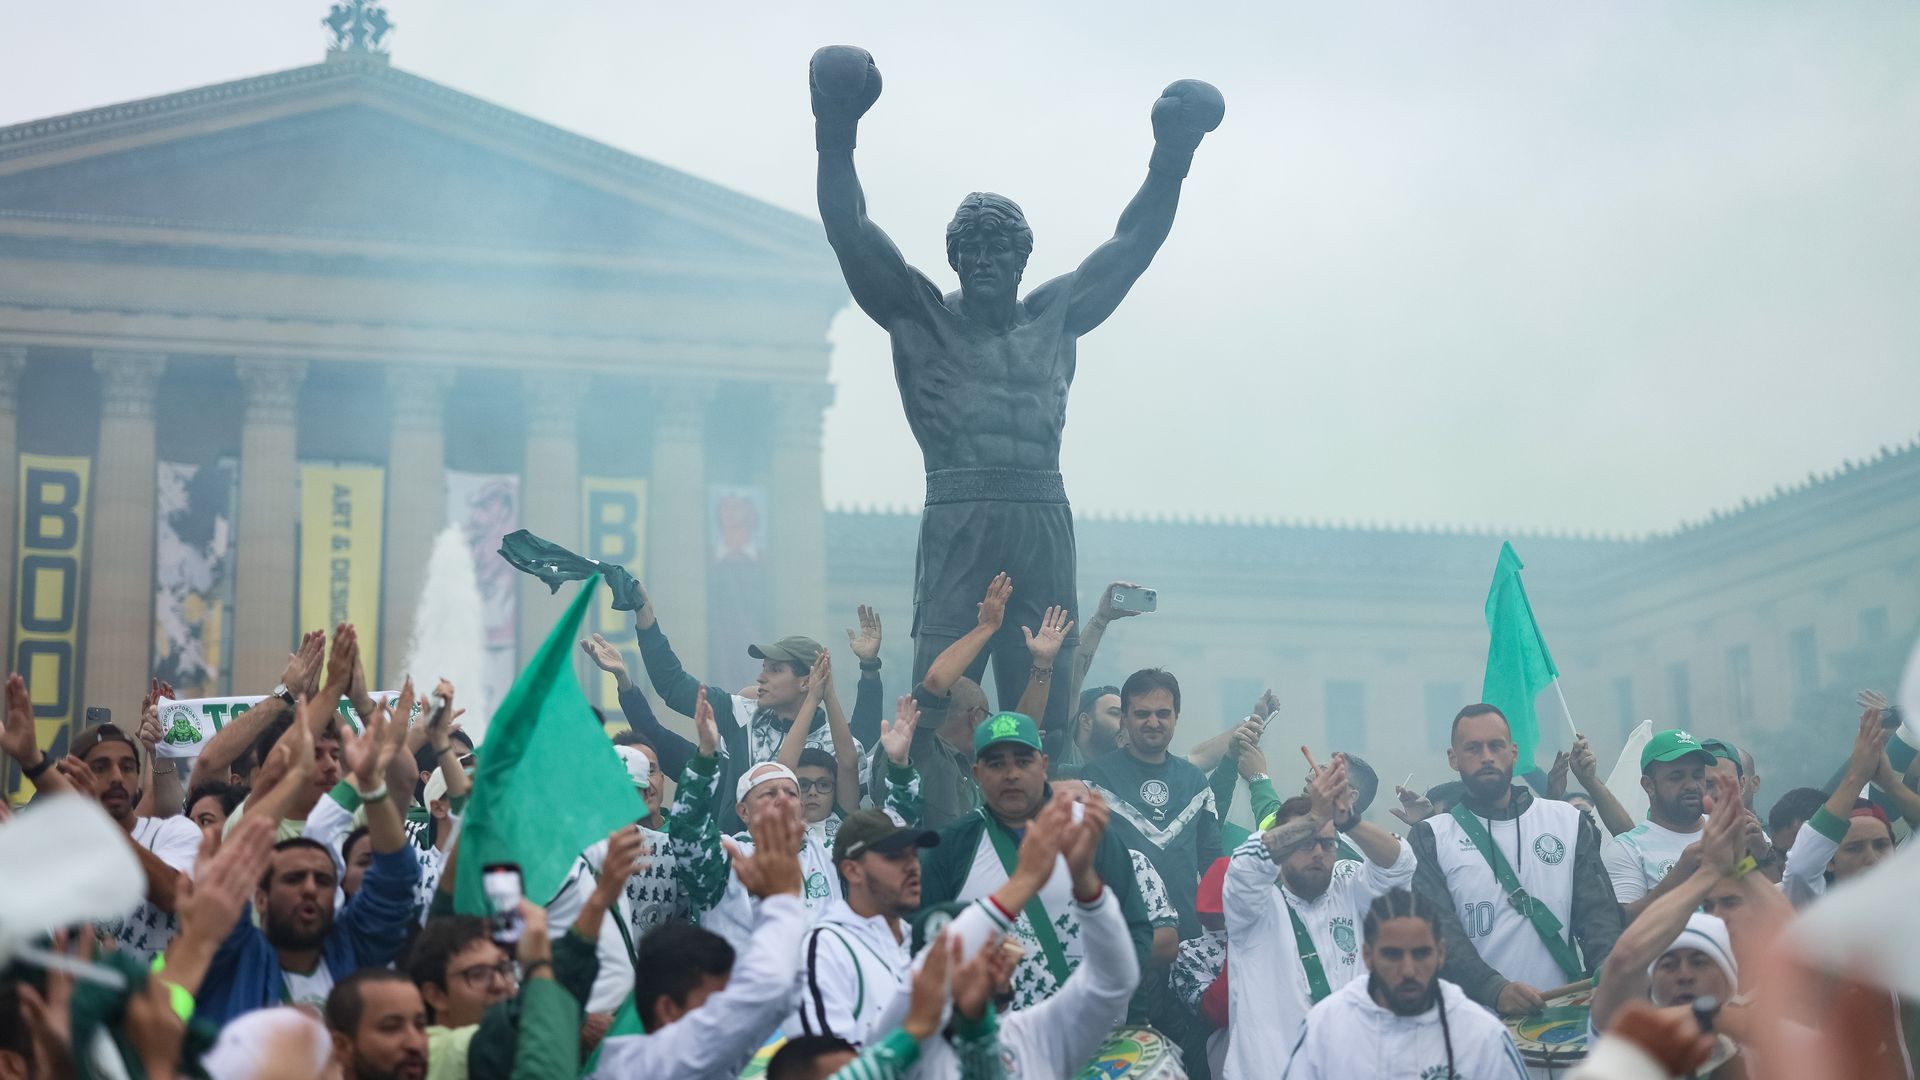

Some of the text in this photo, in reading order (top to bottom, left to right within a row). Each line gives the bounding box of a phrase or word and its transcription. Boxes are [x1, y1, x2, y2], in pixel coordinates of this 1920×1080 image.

[329, 483, 352, 635] ART & DESIG
[178, 704, 201, 726] TORONTO
[1465, 901, 1495, 939] 10
